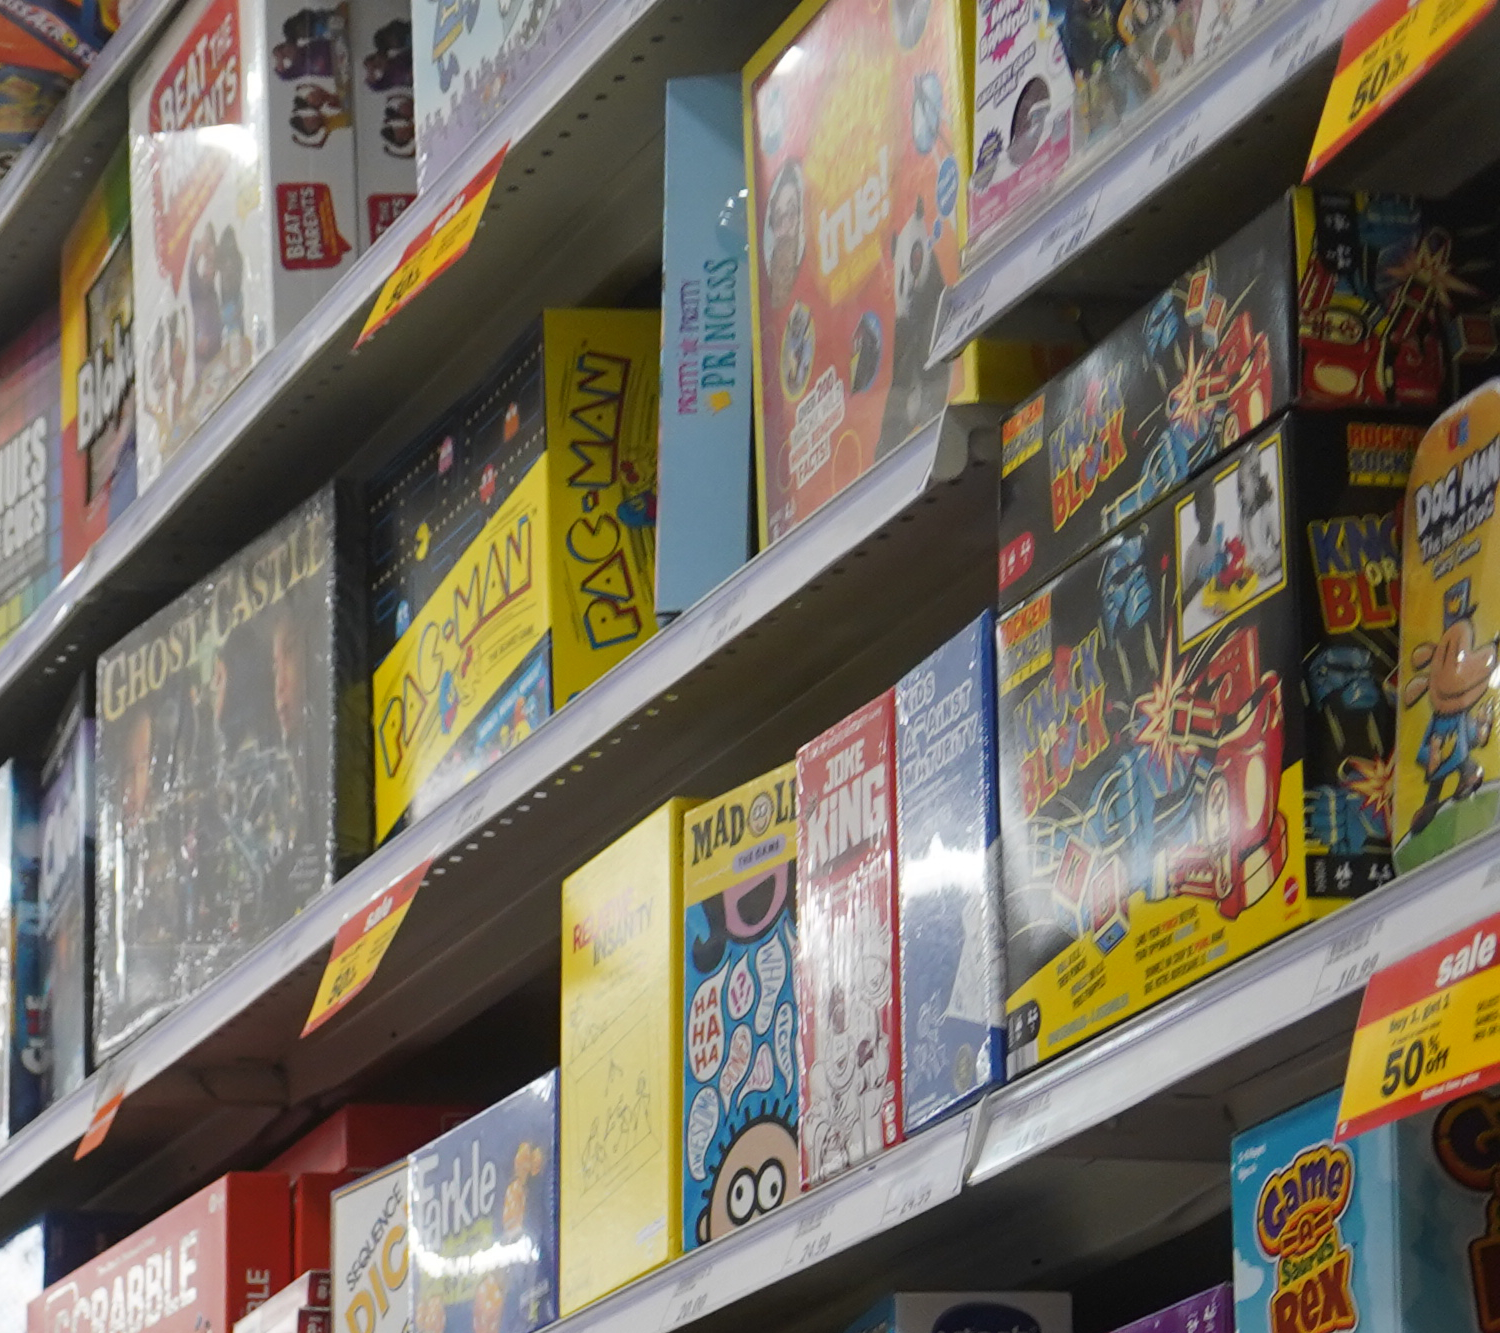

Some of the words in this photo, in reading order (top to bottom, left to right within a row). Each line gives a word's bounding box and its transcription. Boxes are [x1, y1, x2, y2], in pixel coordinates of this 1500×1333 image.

[303, 187, 323, 262] PARENTS
[817, 146, 892, 268] true!
[702, 257, 740, 390] PRINCESS
[566, 349, 643, 651] PAC-MAN
[1050, 406, 1128, 533] BLOCK
[1416, 467, 1458, 538] DOG
[1459, 434, 1500, 508] MAN
[103, 612, 203, 721] GHOST
[209, 518, 328, 646] CASTLE
[379, 515, 532, 779] PAC-MAN
[1013, 627, 1101, 749] KNOCK
[824, 740, 865, 791] JOKE
[1019, 683, 1110, 819] BLOCK
[691, 805, 745, 865] MAD
[694, 986, 720, 1018] HA
[1435, 930, 1499, 988] sale
[693, 1017, 722, 1052] HA
[694, 1050, 719, 1077] HA
[1381, 1036, 1440, 1098] 50%
[1424, 1050, 1449, 1076] off
[347, 1181, 404, 1291] SEQUENCE
[416, 1140, 498, 1251] Farkle
